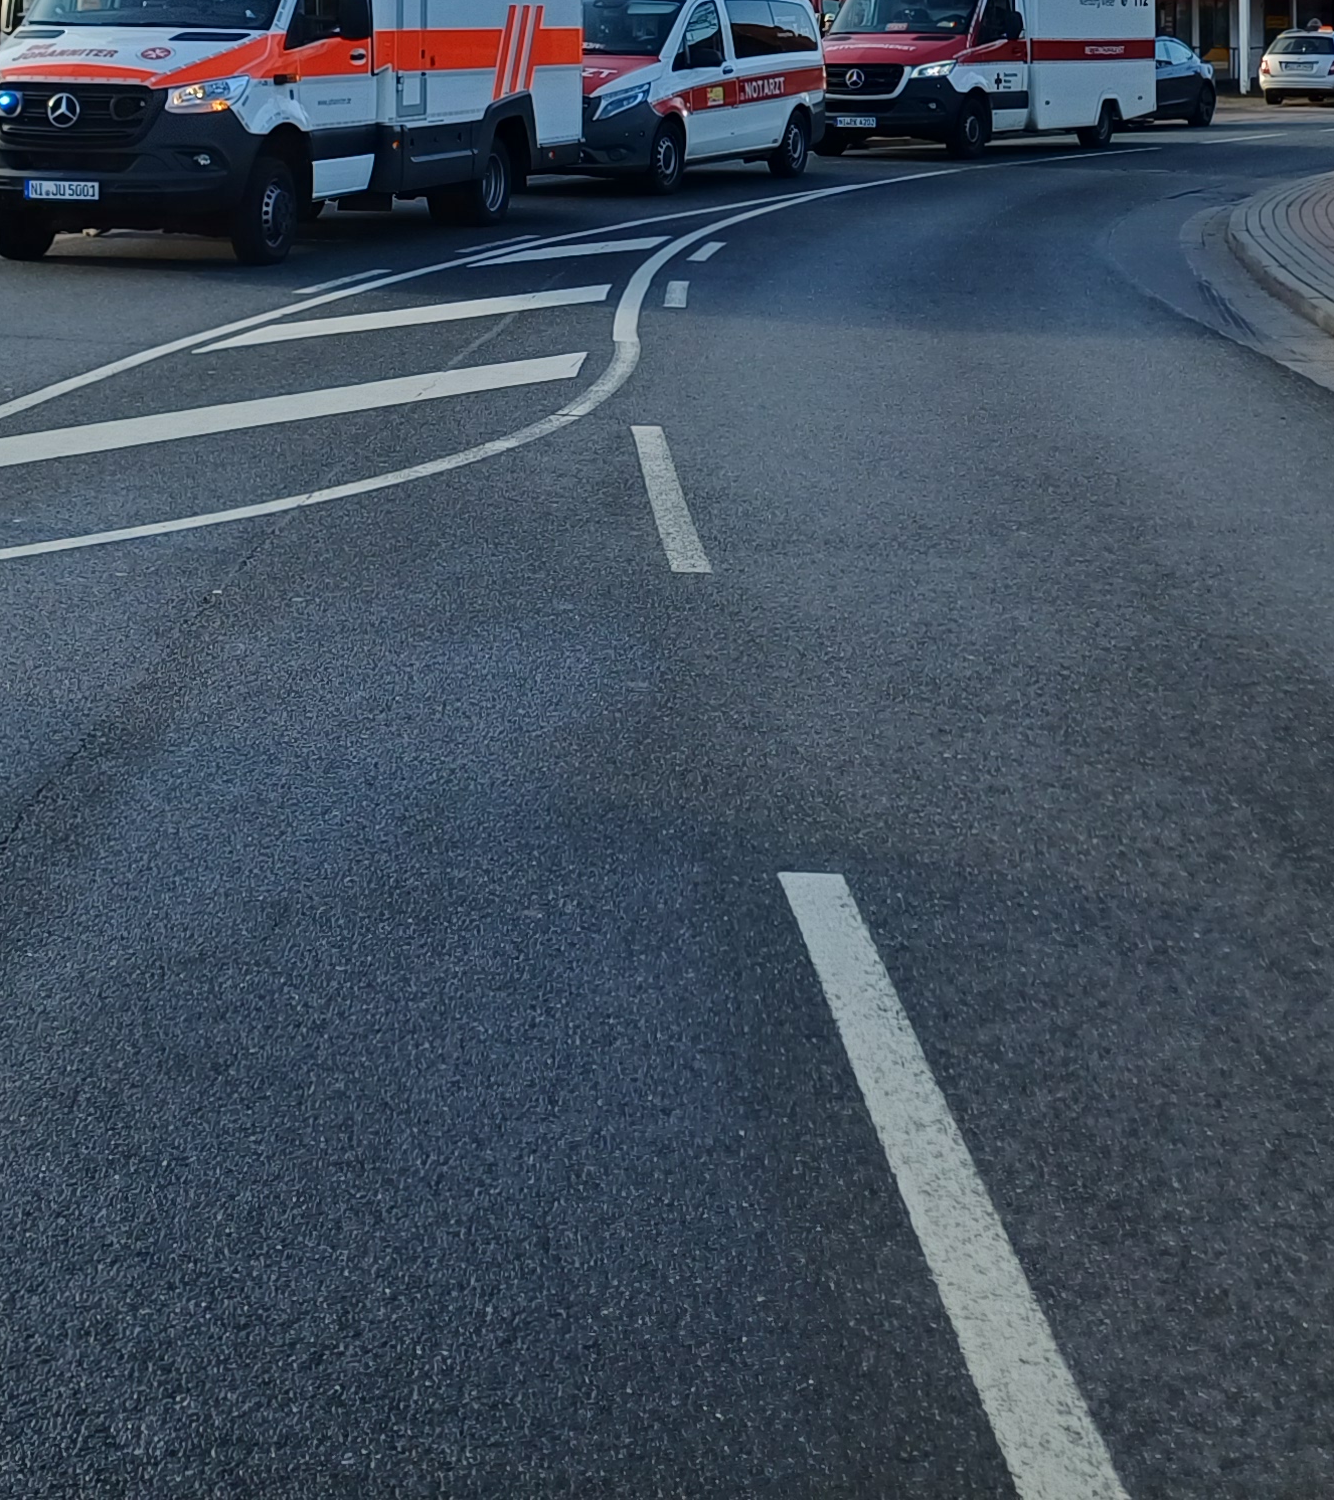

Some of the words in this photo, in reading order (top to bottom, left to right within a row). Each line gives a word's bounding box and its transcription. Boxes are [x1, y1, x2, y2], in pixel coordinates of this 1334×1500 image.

[12, 48, 119, 62] JOHANNITER
[744, 76, 785, 100] NOTARZT
[30, 182, 43, 197] NI
[68, 183, 96, 198] 5001
